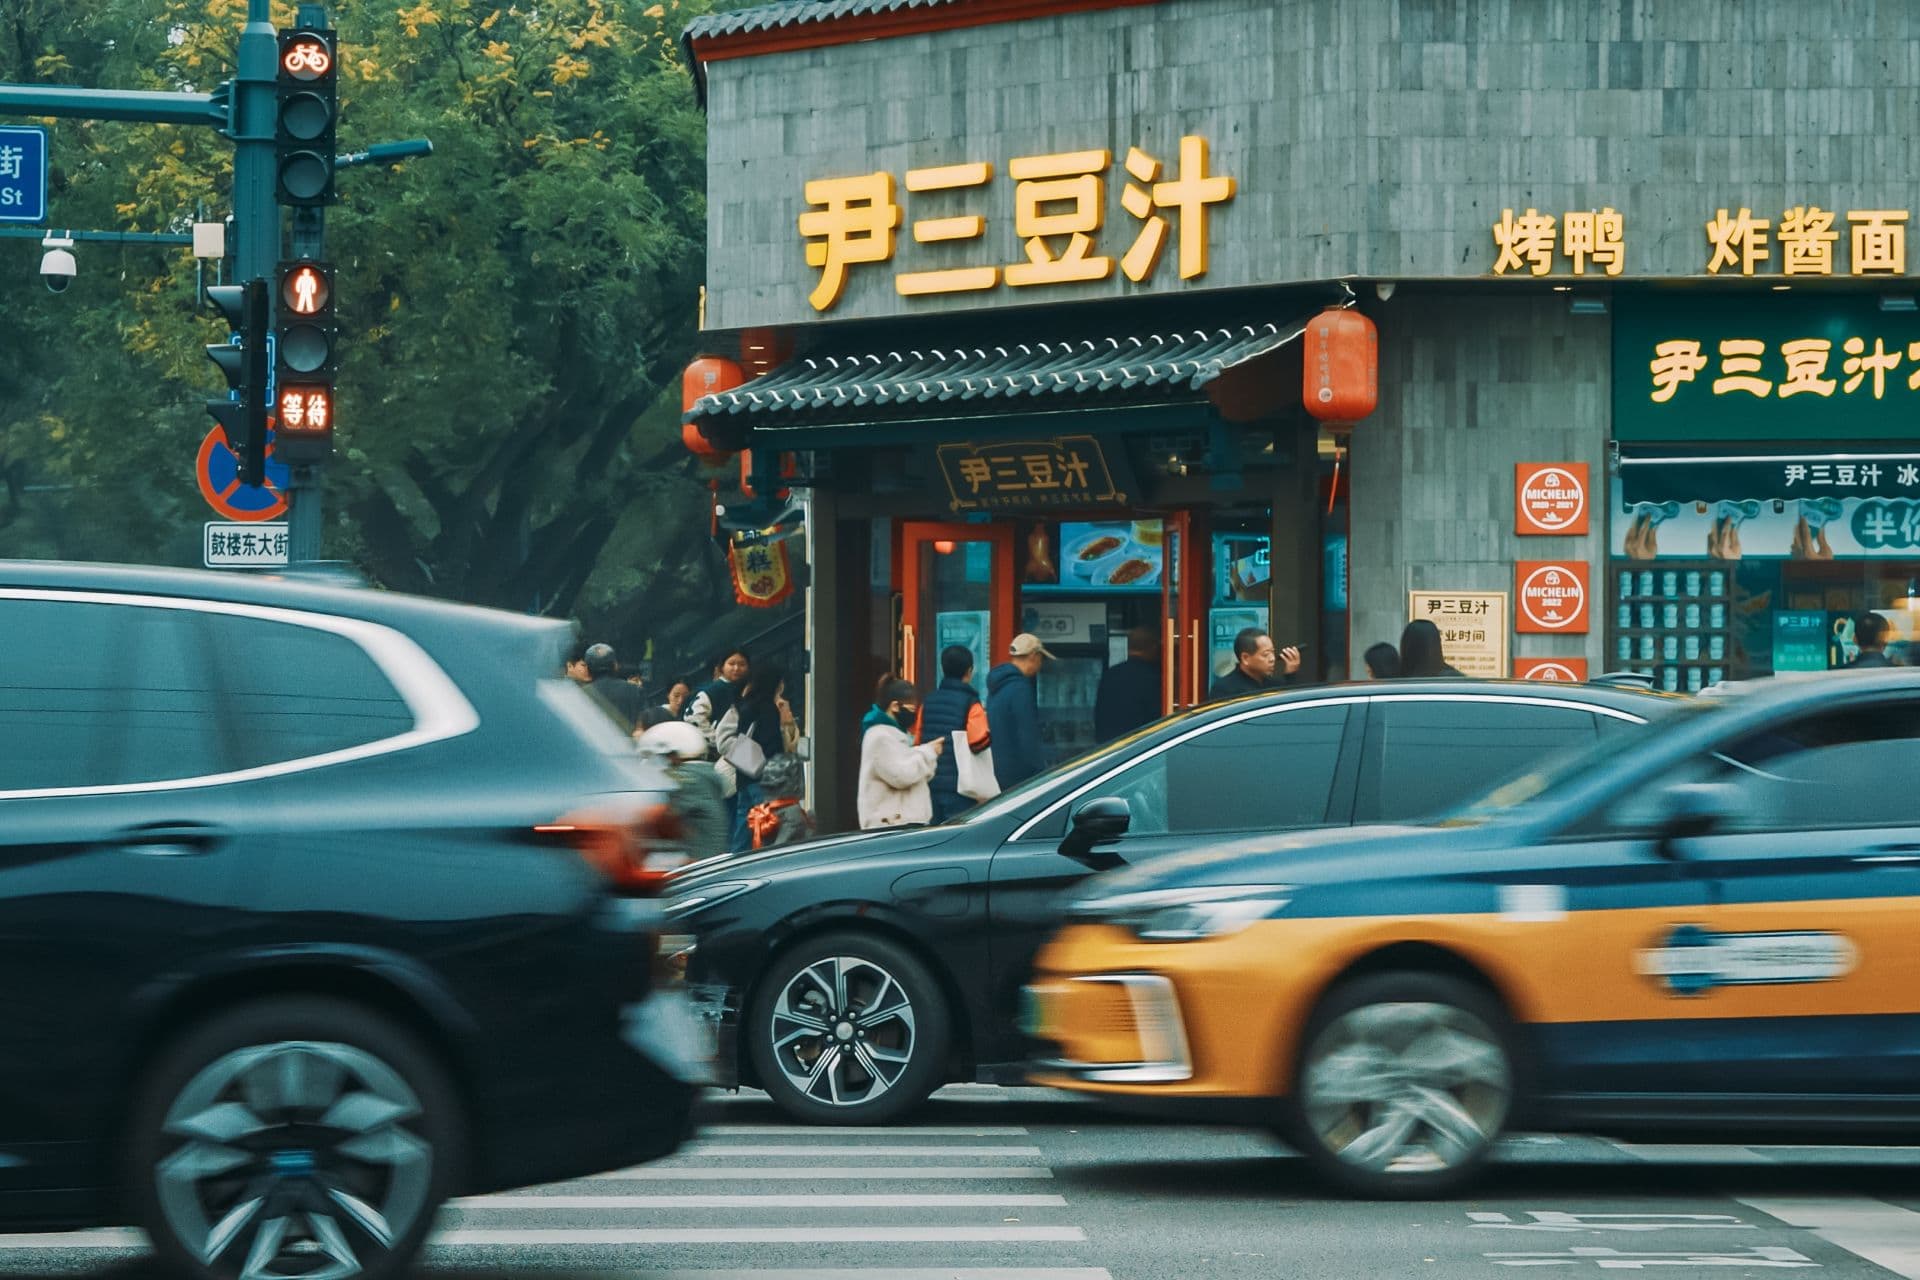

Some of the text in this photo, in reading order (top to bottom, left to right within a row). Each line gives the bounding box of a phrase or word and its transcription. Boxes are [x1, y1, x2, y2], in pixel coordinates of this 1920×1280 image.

[1, 187, 23, 206] St
[799, 136, 1236, 311] 尹三豆汁
[1493, 206, 1909, 276] 烤鸭 炸酱面
[282, 393, 326, 427] 等待
[959, 451, 1089, 494] 尹三豆汁
[1785, 464, 1883, 487] 尹三豆汁
[1527, 489, 1579, 500] MICHELIN
[211, 532, 288, 557] 鼓楼东大街
[1527, 587, 1579, 598] MICHELIN
[1427, 599, 1489, 615] 尹三豆汁
[1440, 630, 1485, 642] 业时间
